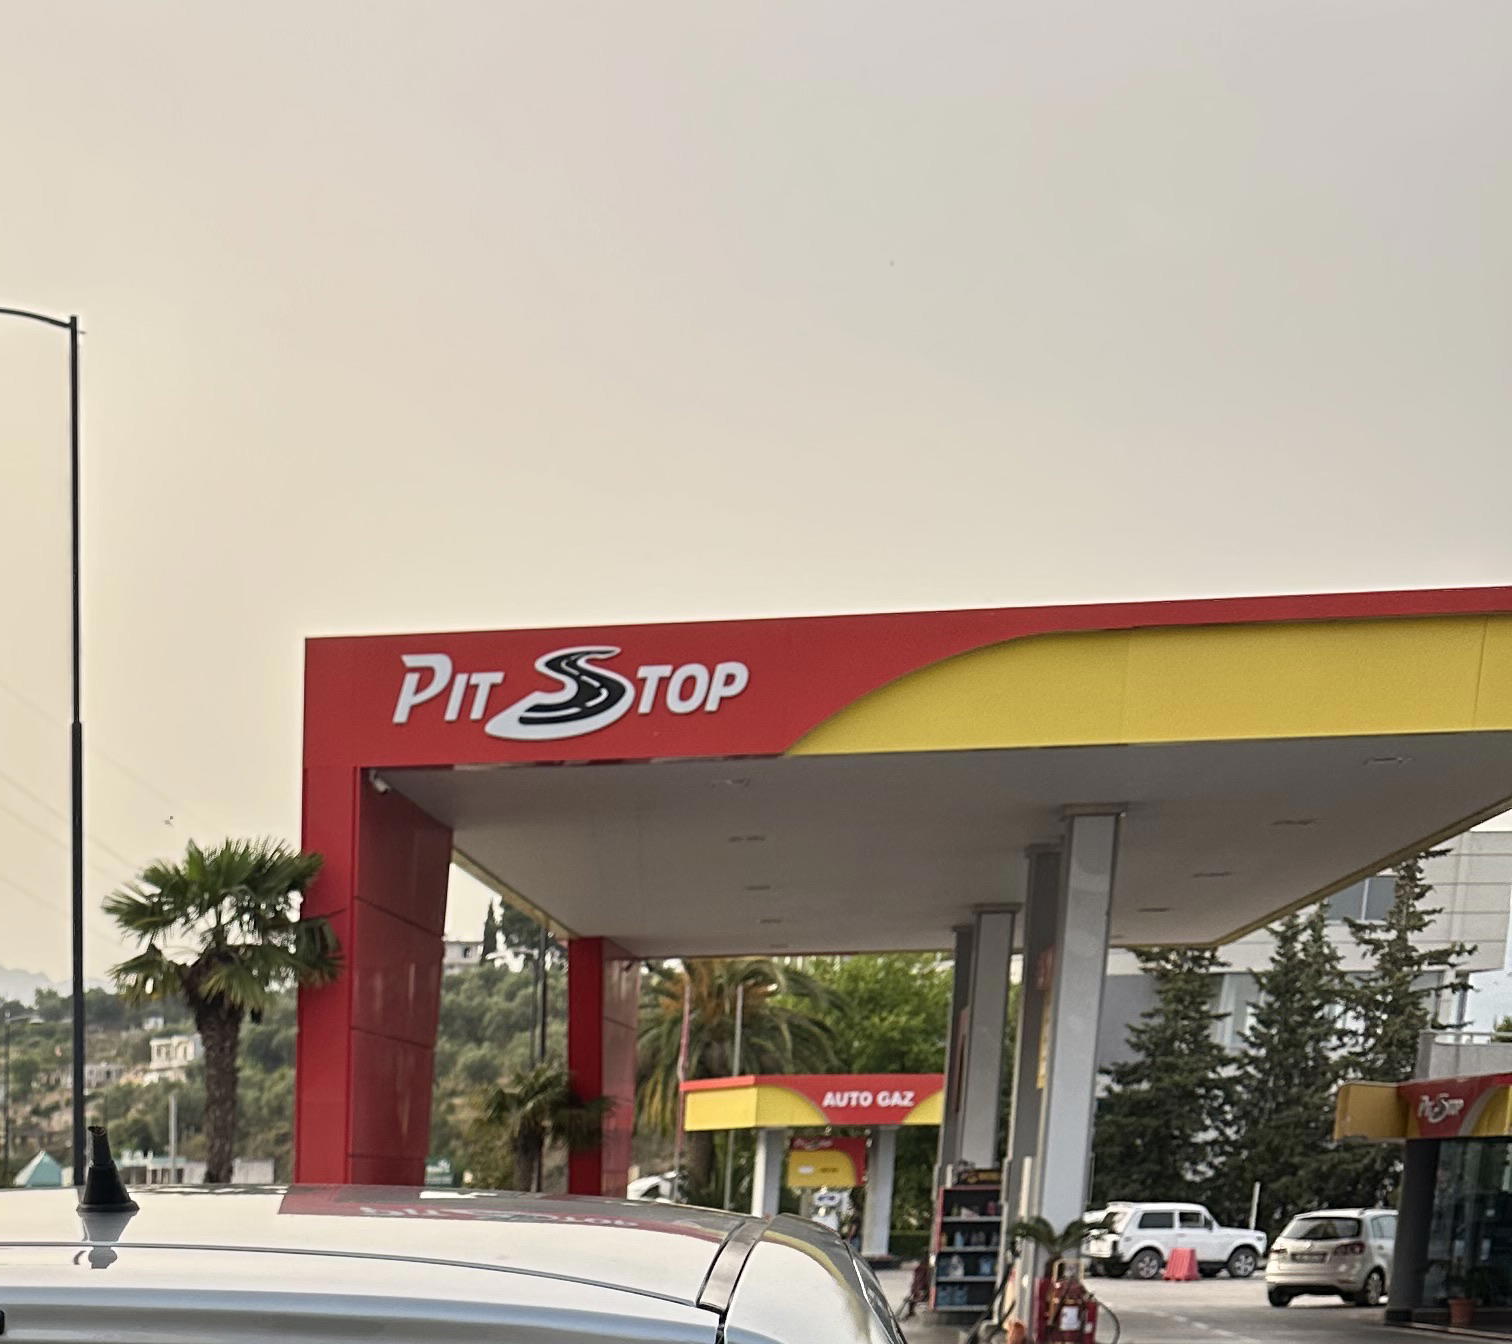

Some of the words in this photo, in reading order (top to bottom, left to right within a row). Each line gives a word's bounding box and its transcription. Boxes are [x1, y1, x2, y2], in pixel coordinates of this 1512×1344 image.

[391, 653, 505, 725] PIT
[484, 645, 750, 741] STOP
[822, 1090, 873, 1108] AUTO
[876, 1090, 916, 1108] GAZ
